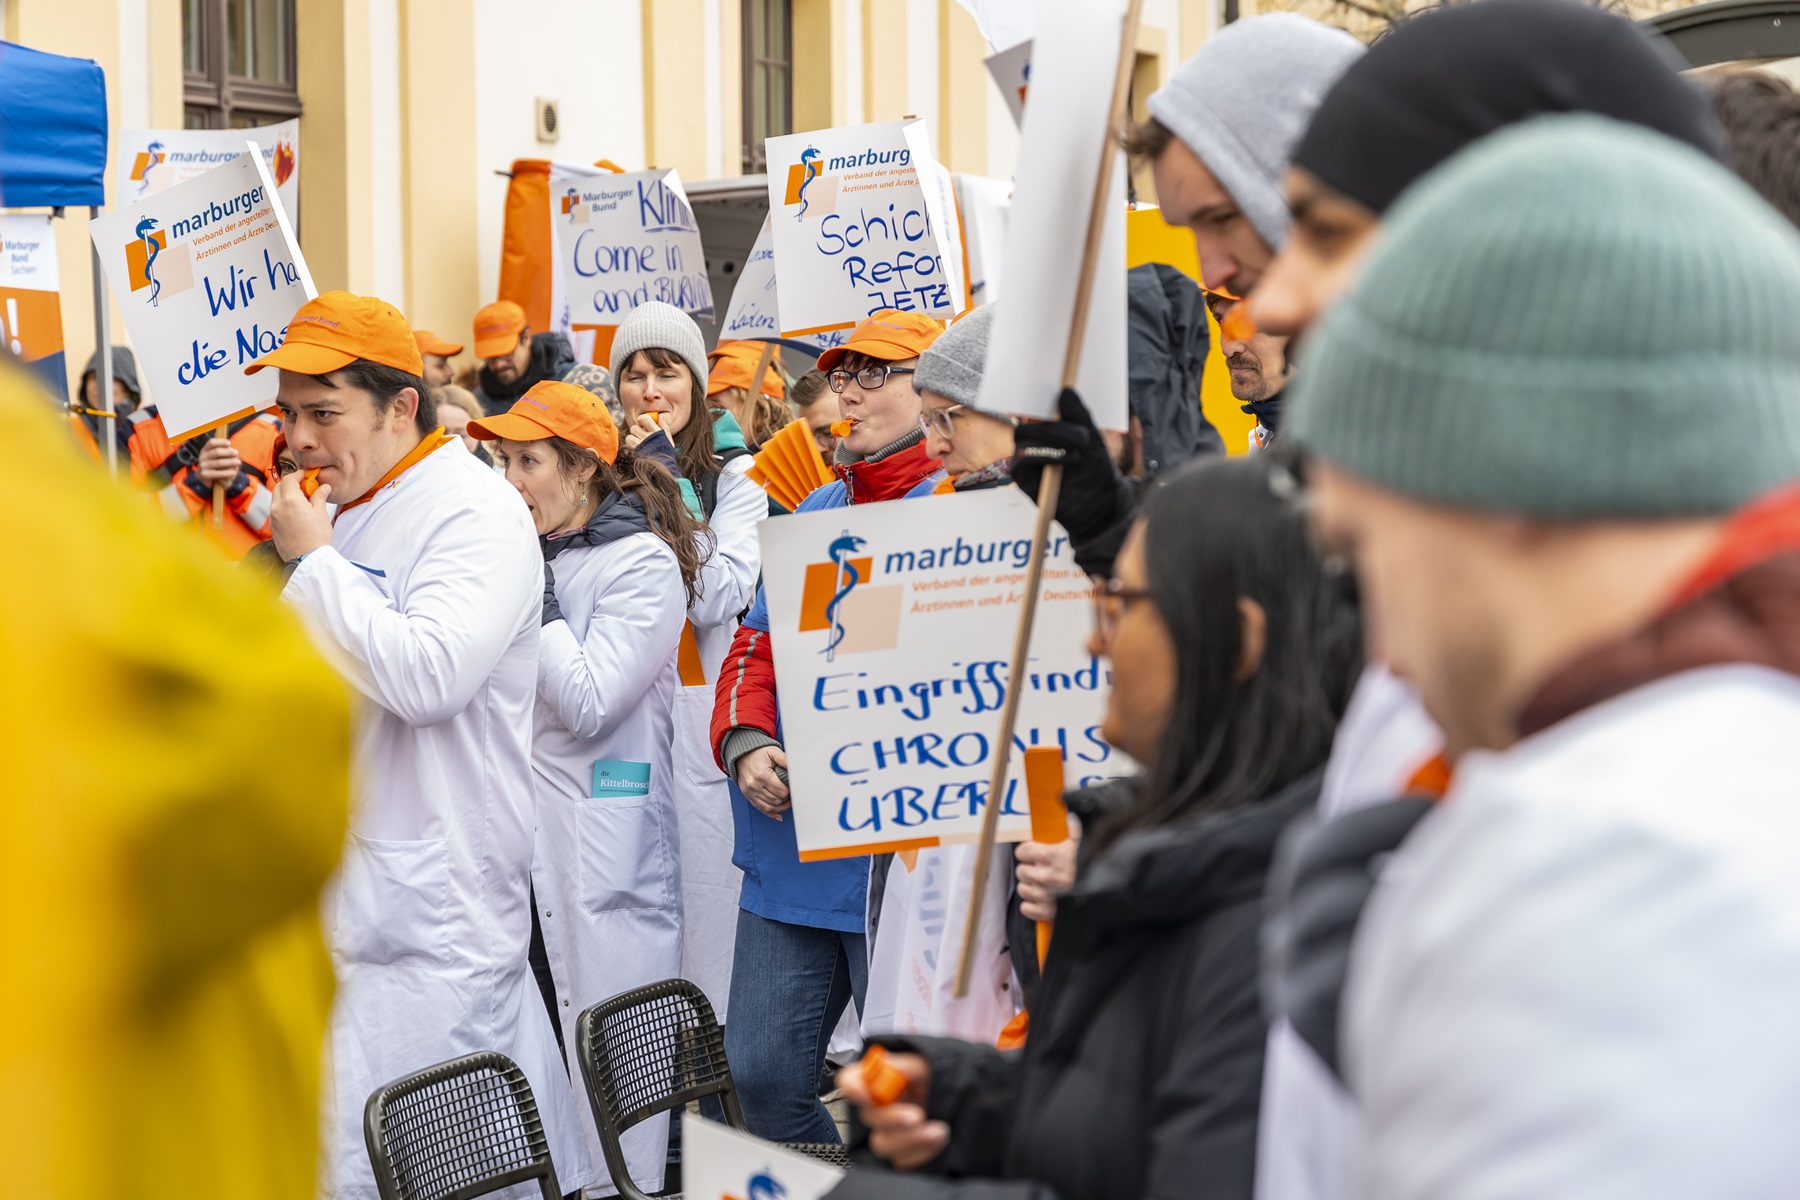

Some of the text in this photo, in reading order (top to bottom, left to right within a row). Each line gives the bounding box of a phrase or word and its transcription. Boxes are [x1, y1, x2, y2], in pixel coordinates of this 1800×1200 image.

[829, 148, 911, 171] marburg
[843, 170, 874, 181] Verband
[875, 168, 887, 177] der
[582, 188, 634, 203] Marburger
[842, 181, 878, 193] Ärztinnen
[879, 179, 894, 189] und
[895, 178, 915, 187] Ärzte
[172, 185, 265, 239] marburger
[592, 201, 617, 212] Bund
[192, 227, 224, 246] Verband
[225, 223, 237, 234] der
[196, 240, 232, 261] Ärztinnen
[233, 232, 247, 245] und
[248, 226, 265, 238] Ärzte
[5, 240, 39, 252] Marburger
[573, 229, 684, 278] Come in
[11, 253, 28, 263] Bund
[12, 265, 36, 275] Sachsen
[203, 248, 300, 317] Wir ha
[593, 281, 649, 313] and
[177, 339, 231, 385] die
[912, 575, 967, 593] Verband
[969, 573, 991, 587] der
[910, 598, 975, 614] Ärztinnen
[977, 593, 1003, 607] und
